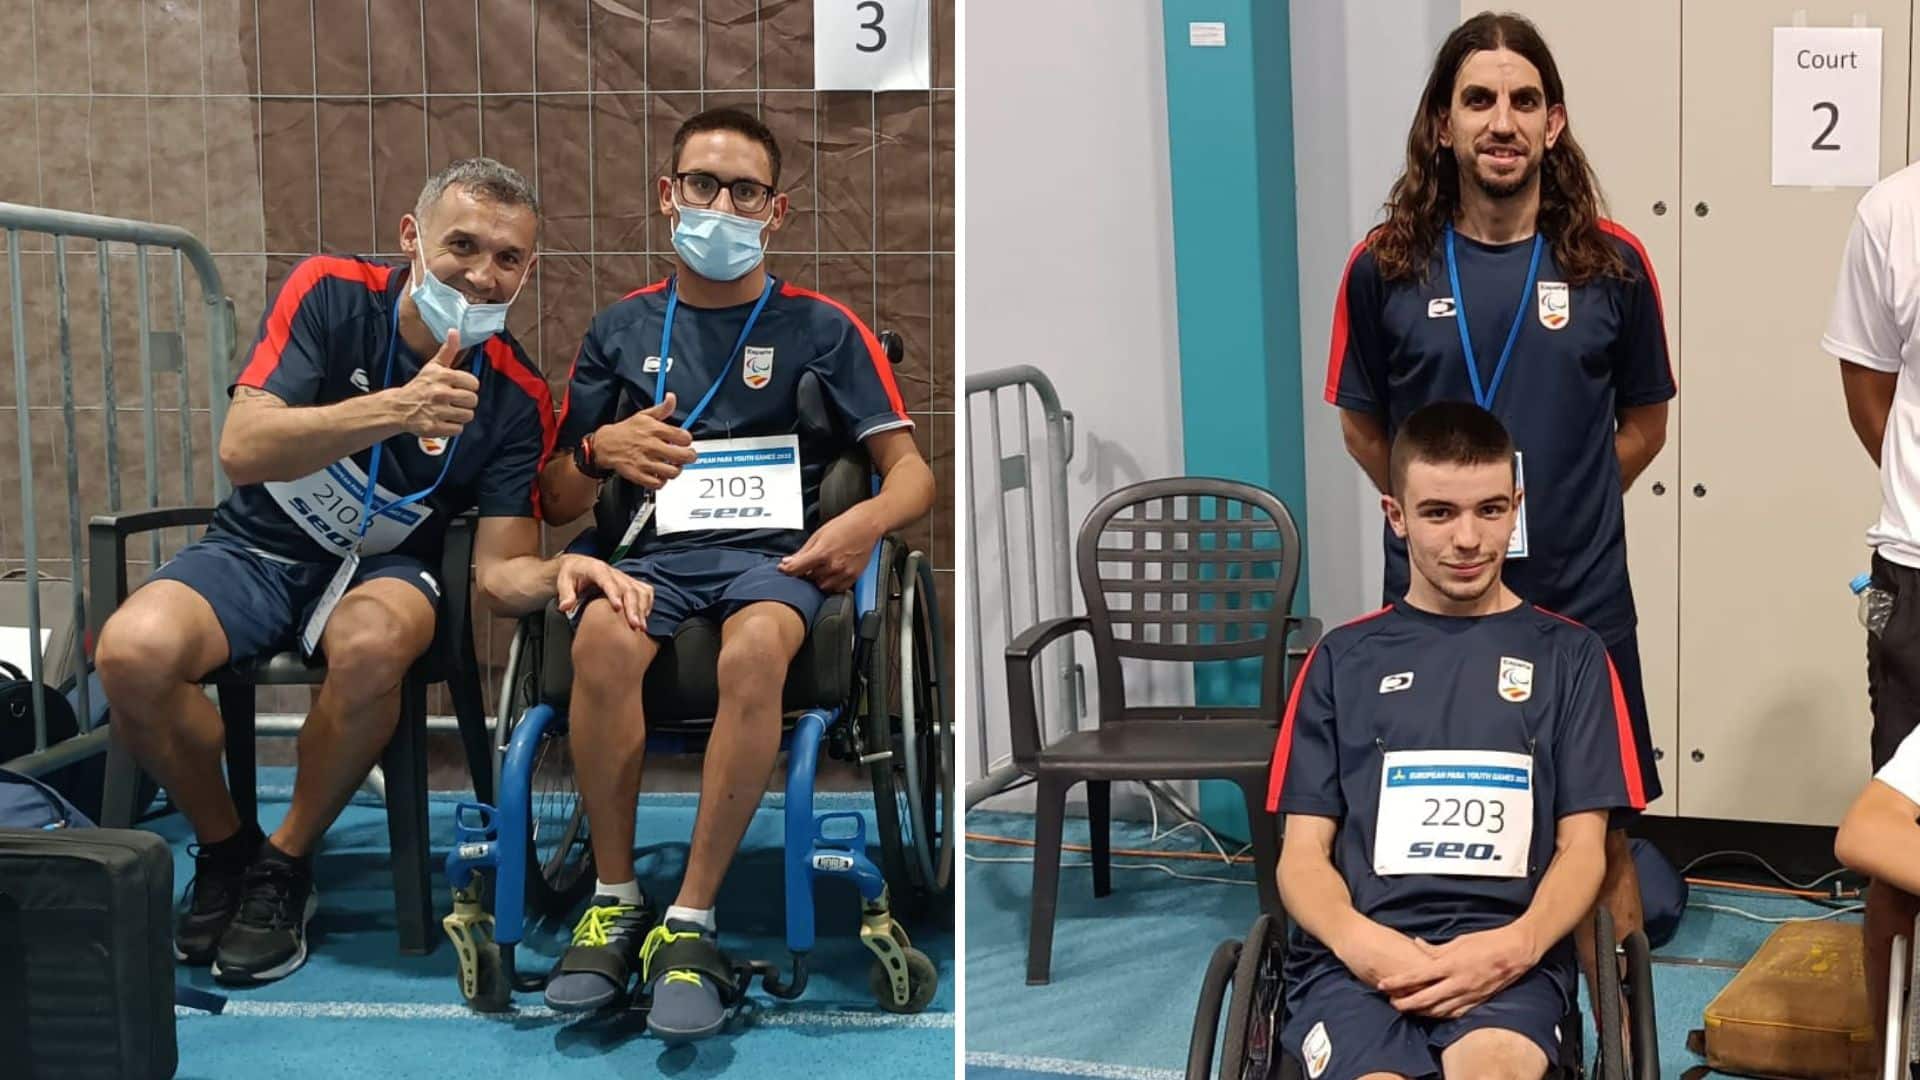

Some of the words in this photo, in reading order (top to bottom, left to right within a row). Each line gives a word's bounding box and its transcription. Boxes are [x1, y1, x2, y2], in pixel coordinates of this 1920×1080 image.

[855, 1, 887, 53] 3
[1796, 49, 1858, 69] Court
[1811, 101, 1841, 150] 2
[698, 475, 765, 501] 2103
[1421, 798, 1505, 834] 2203
[1406, 841, 1503, 861] seo.
